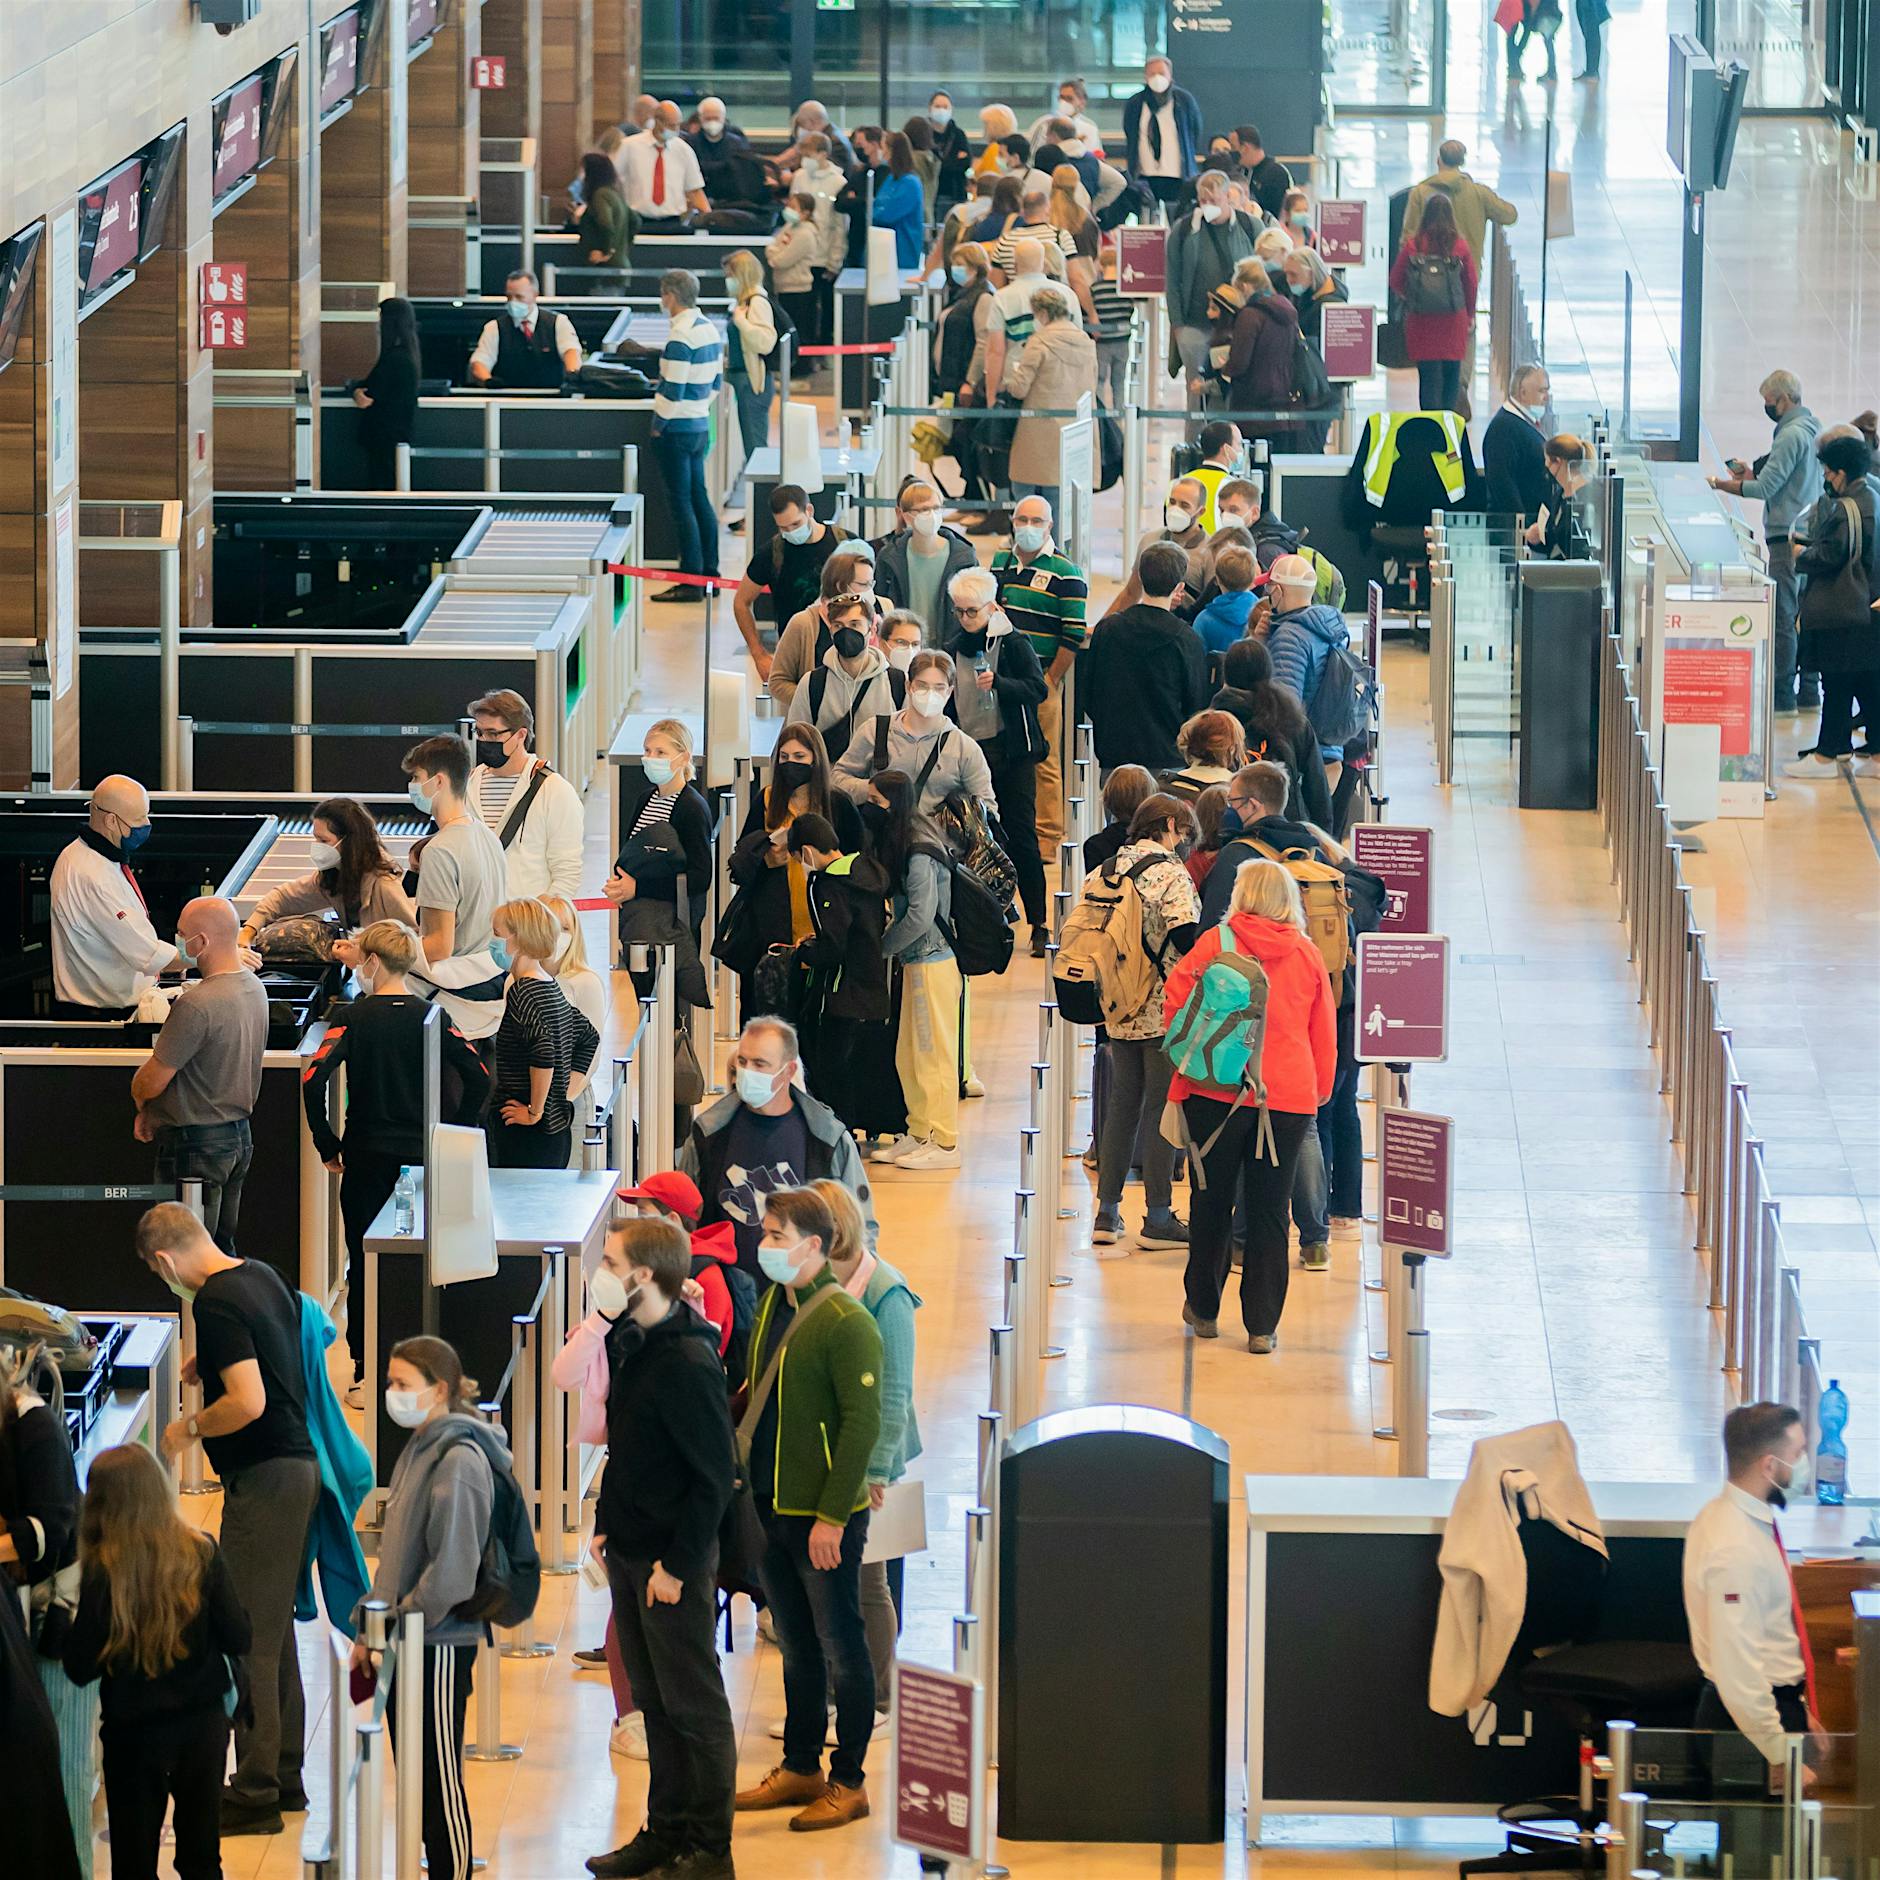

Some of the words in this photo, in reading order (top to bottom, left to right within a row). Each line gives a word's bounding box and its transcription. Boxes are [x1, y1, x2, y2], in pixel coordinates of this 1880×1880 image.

[129, 192, 138, 231] 25
[1665, 615, 1681, 628] ER
[291, 726, 308, 734] BER
[401, 726, 419, 734] BER
[104, 1187, 128, 1198] BER
[1633, 1763, 1660, 1781] ER
